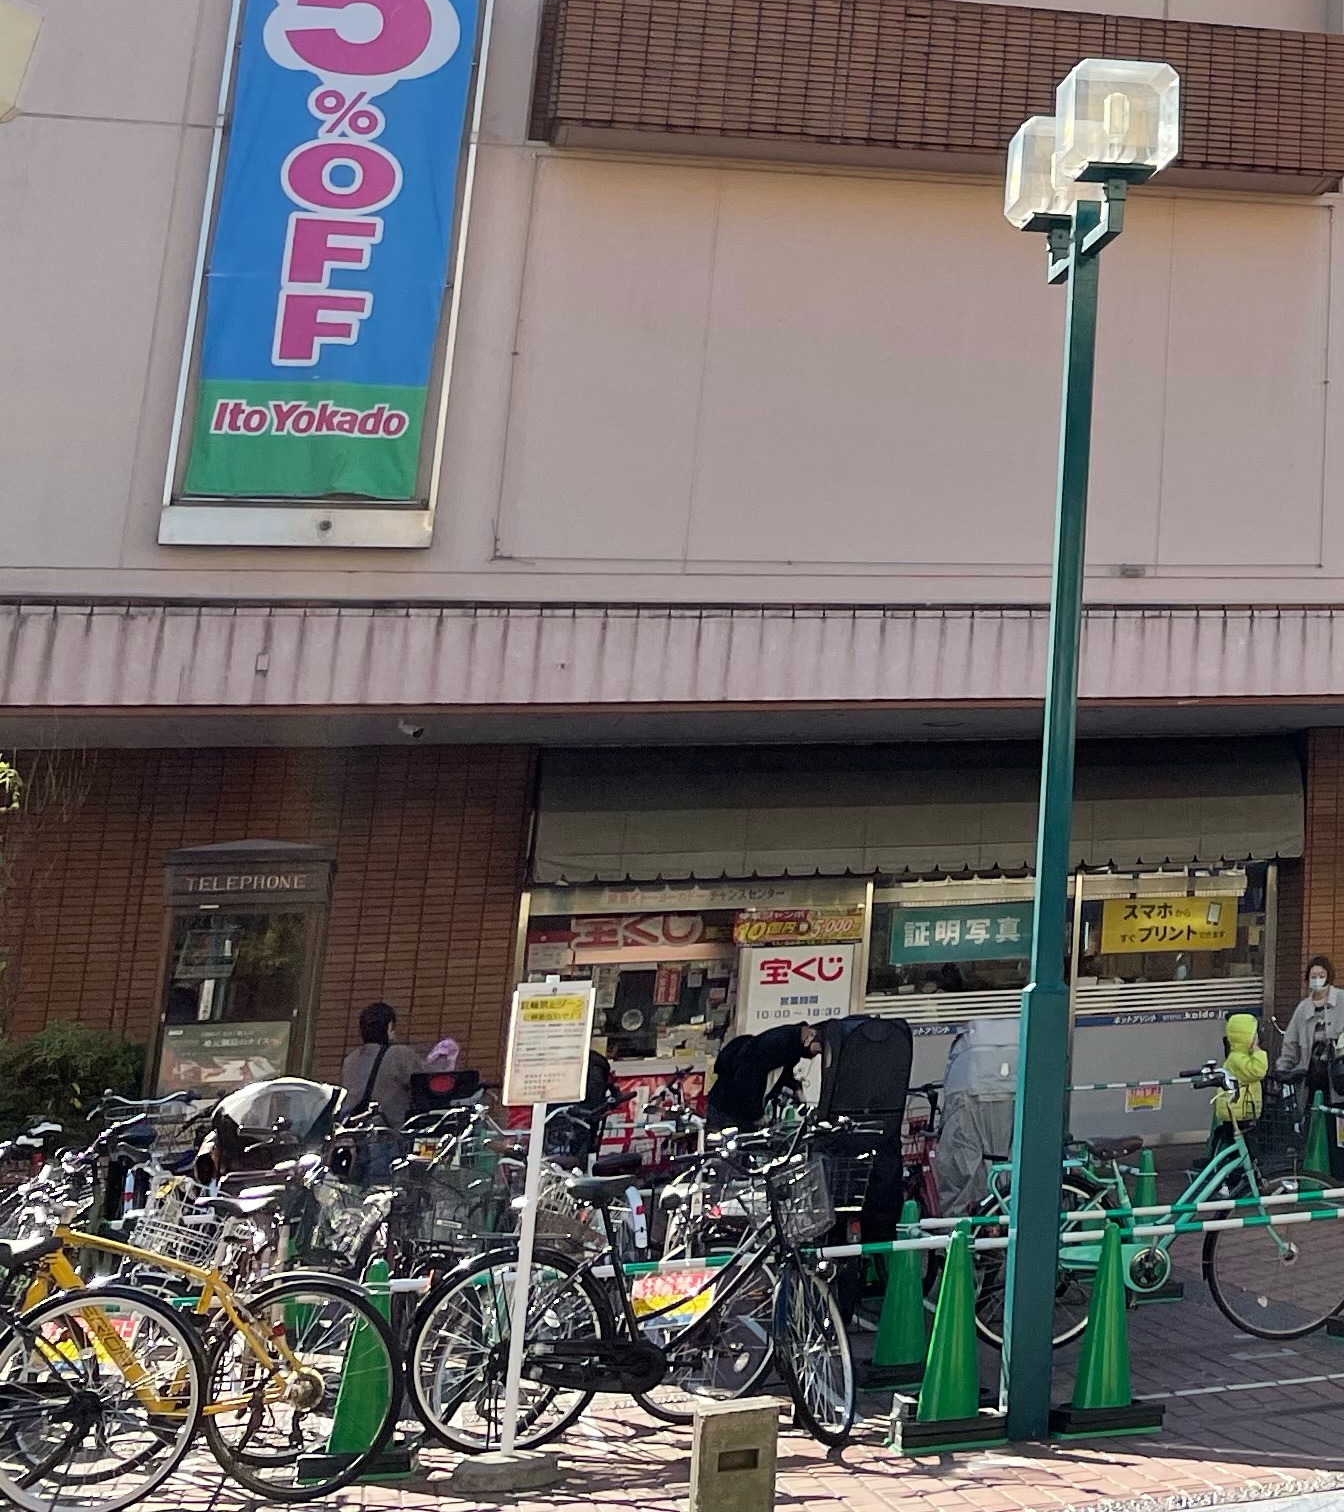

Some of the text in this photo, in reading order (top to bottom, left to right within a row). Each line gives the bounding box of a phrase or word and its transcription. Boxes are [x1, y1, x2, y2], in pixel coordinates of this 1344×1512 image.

[186, 874, 307, 892] TELEPHONE
[904, 917, 1021, 948] 証明写真
[760, 957, 844, 985] 宝くじ
